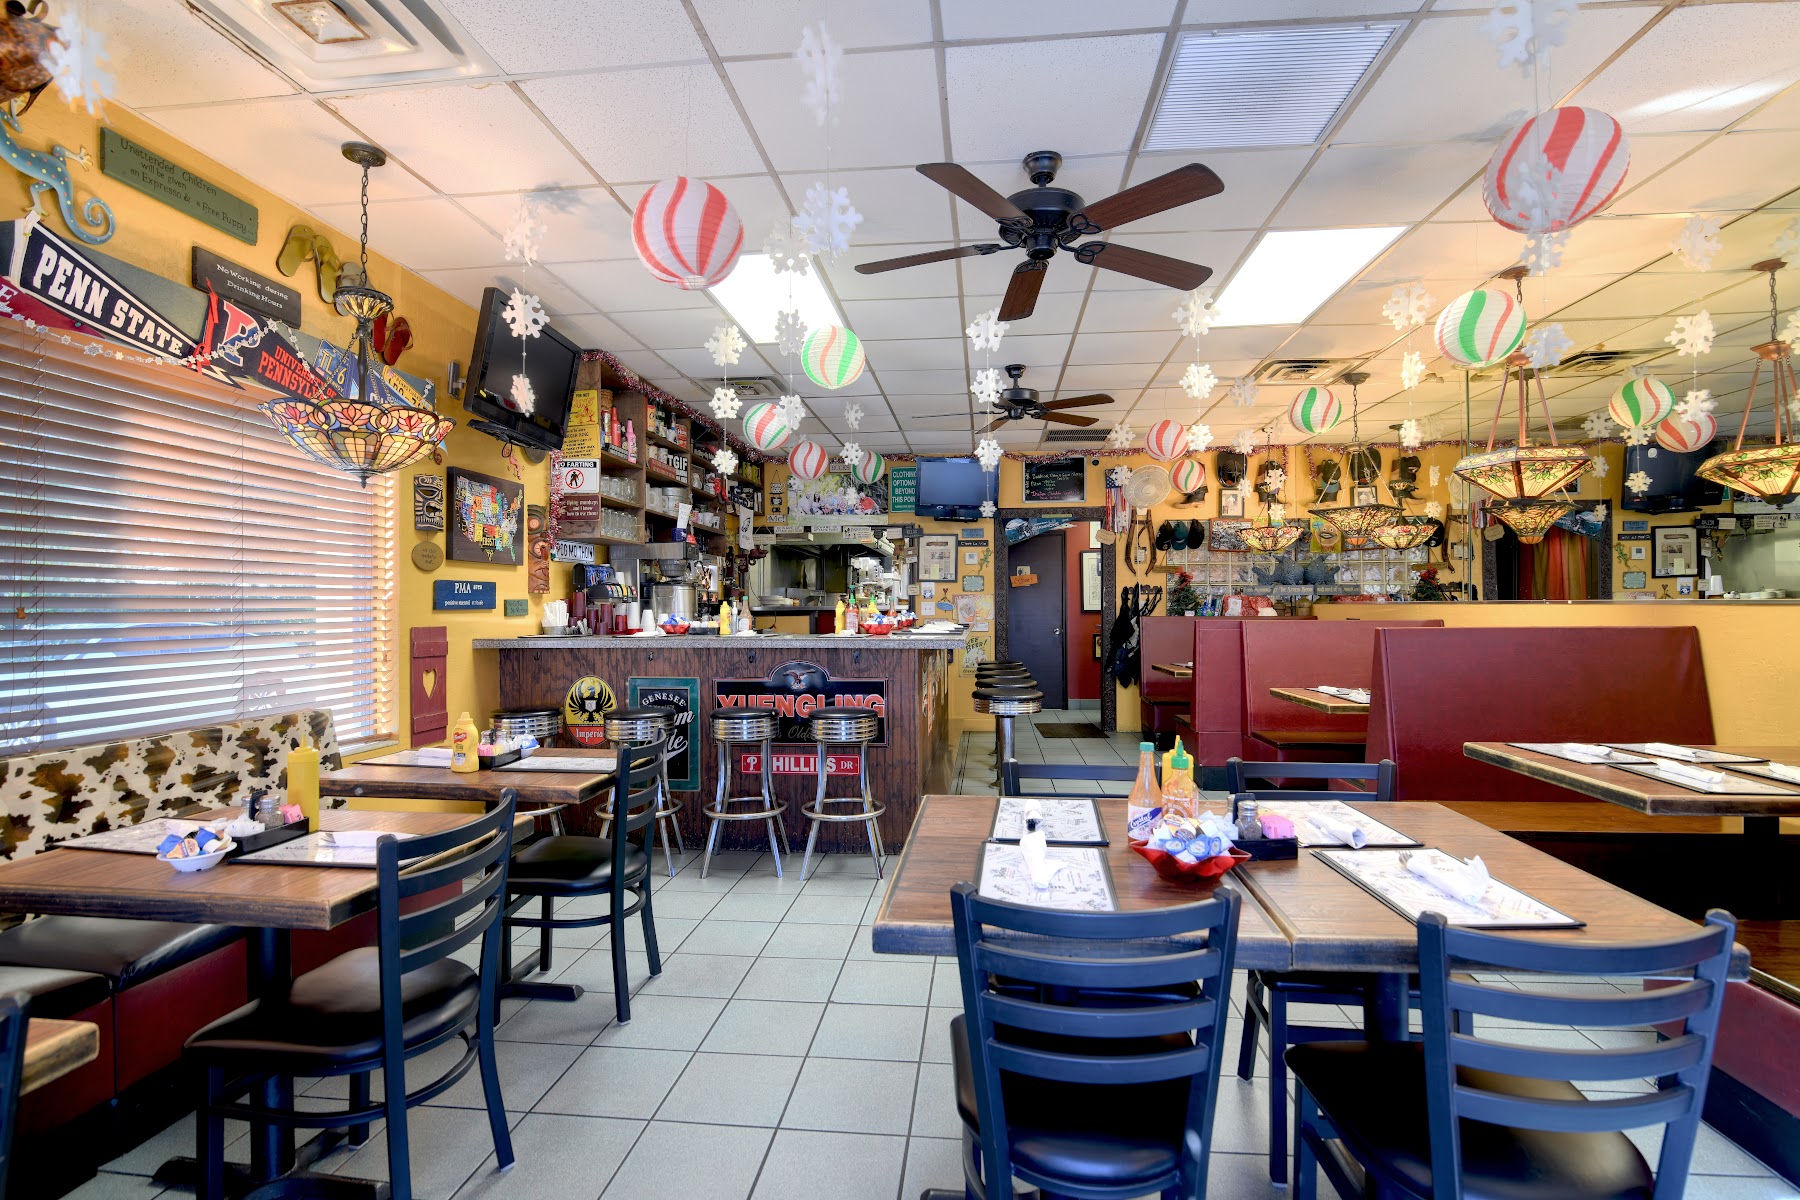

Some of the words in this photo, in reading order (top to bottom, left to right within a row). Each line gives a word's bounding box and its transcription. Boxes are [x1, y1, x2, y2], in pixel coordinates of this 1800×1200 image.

[120, 138, 176, 175] Unattended
[182, 171, 217, 196] Children
[140, 162, 154, 175] will
[156, 168, 165, 179] be
[167, 176, 187, 191] given
[130, 168, 140, 178] an
[142, 171, 182, 199] Expresso
[184, 193, 191, 202] &
[202, 202, 221, 218] Free
[216, 263, 229, 274] No
[230, 270, 262, 289] Working
[264, 285, 289, 300] during
[227, 280, 261, 300] Drinking
[261, 294, 283, 309] Hours
[32, 244, 109, 319] PENN
[110, 299, 183, 356] STATE
[217, 299, 261, 367] P
[667, 454, 688, 471] TGIF
[454, 582, 472, 594] PMA
[642, 692, 686, 707] GENESEE
[575, 728, 604, 742] Imperia
[747, 756, 758, 771] P
[840, 760, 853, 770] DR
